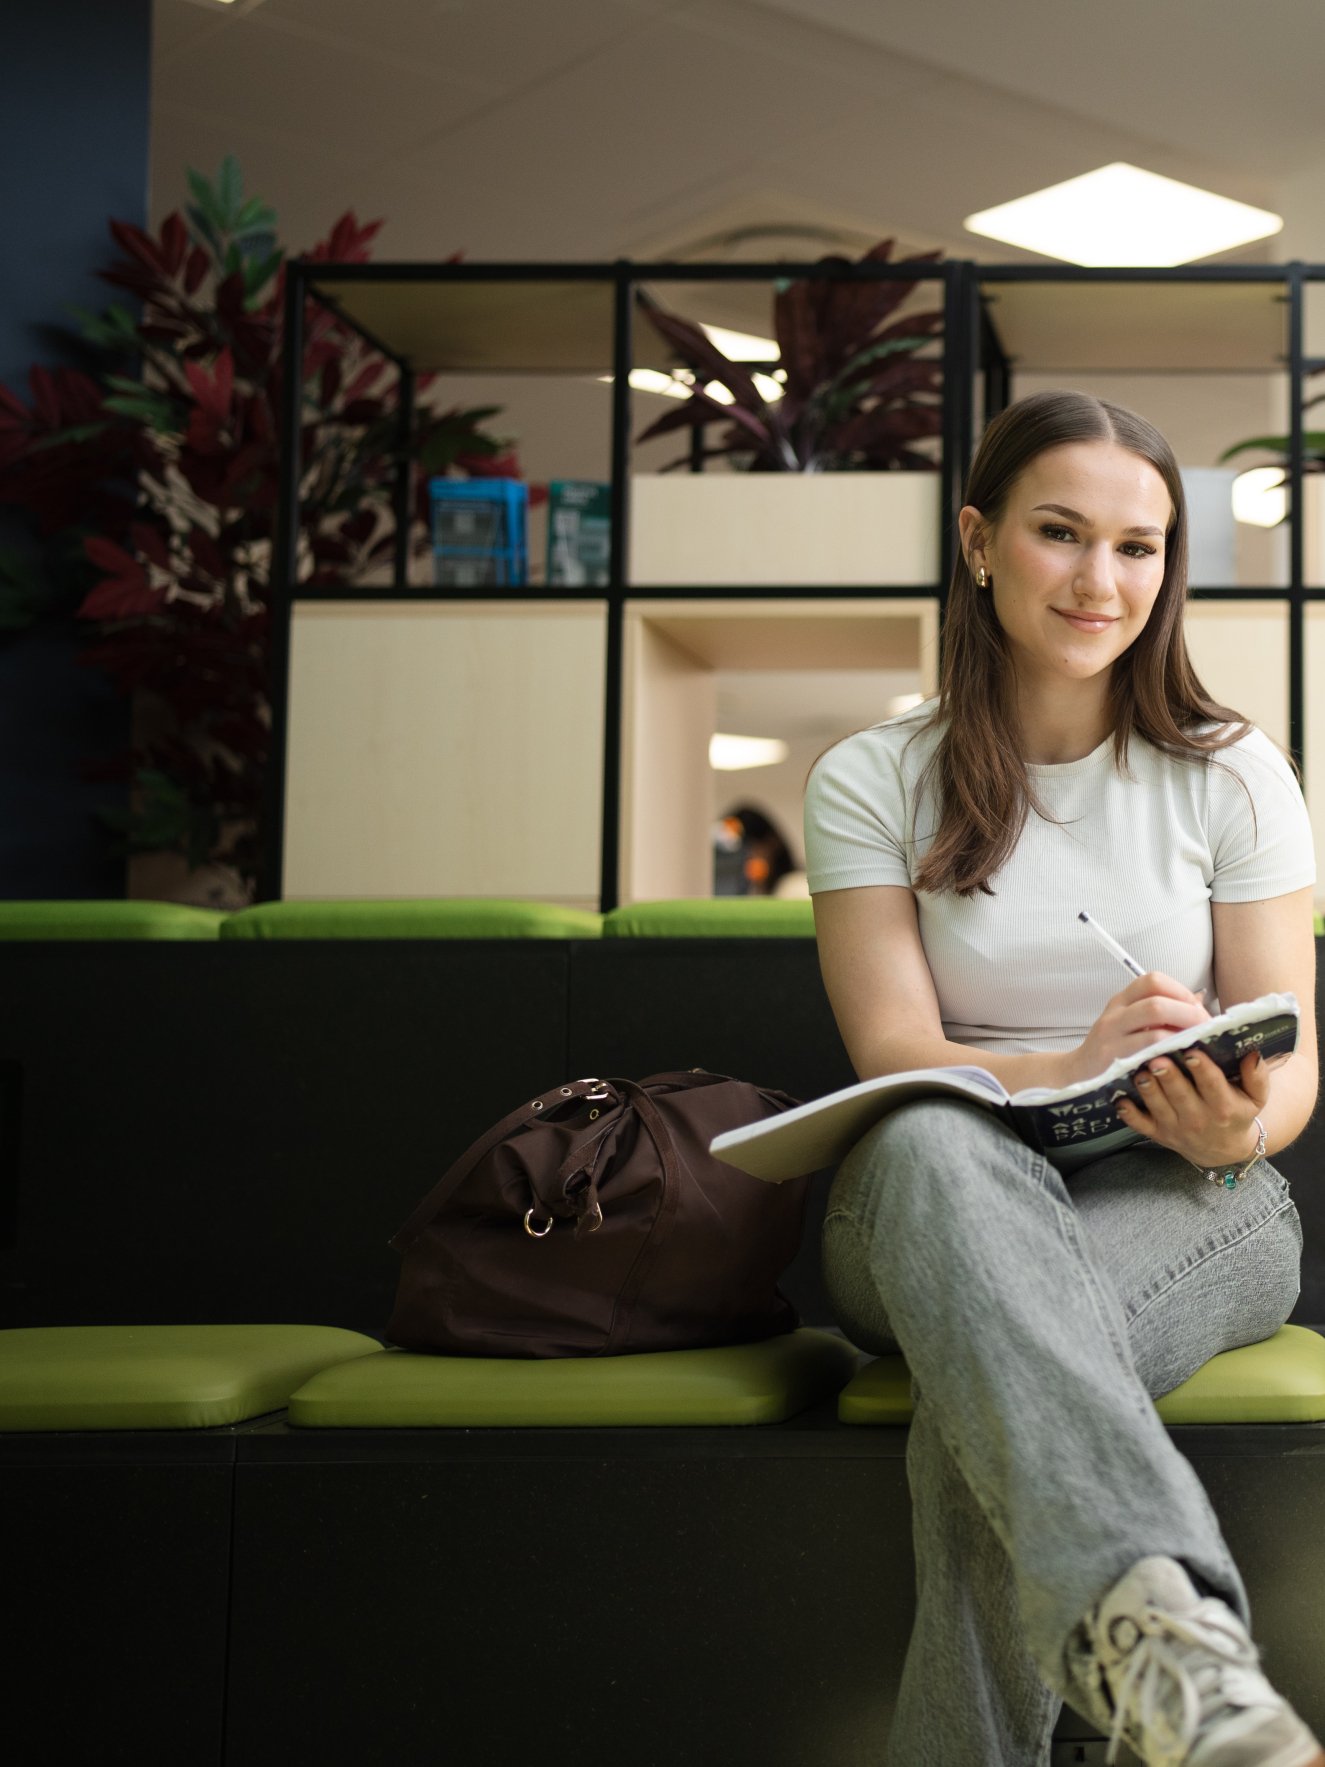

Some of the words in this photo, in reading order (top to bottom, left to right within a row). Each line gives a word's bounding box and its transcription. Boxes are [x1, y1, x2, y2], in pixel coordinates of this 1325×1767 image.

[1235, 1032, 1264, 1048] 120
[1054, 1114, 1121, 1135] REFI
[1056, 1124, 1109, 1141] PAD
